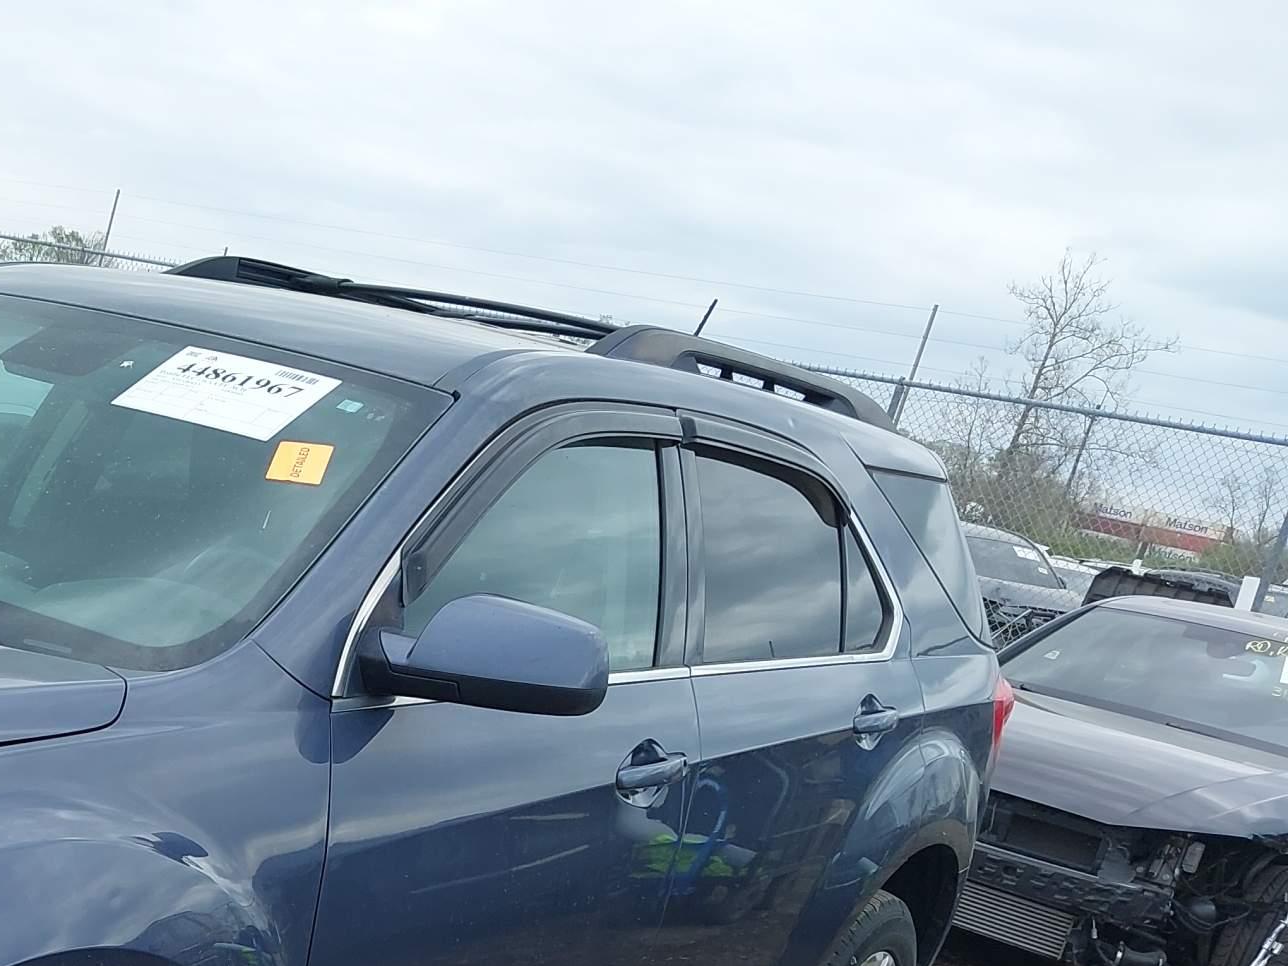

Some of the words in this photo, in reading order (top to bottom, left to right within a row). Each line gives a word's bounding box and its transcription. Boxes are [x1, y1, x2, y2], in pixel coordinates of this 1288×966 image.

[177, 362, 305, 398] 44861967
[290, 447, 310, 478] DETAILED
[1165, 517, 1209, 534] Matson
